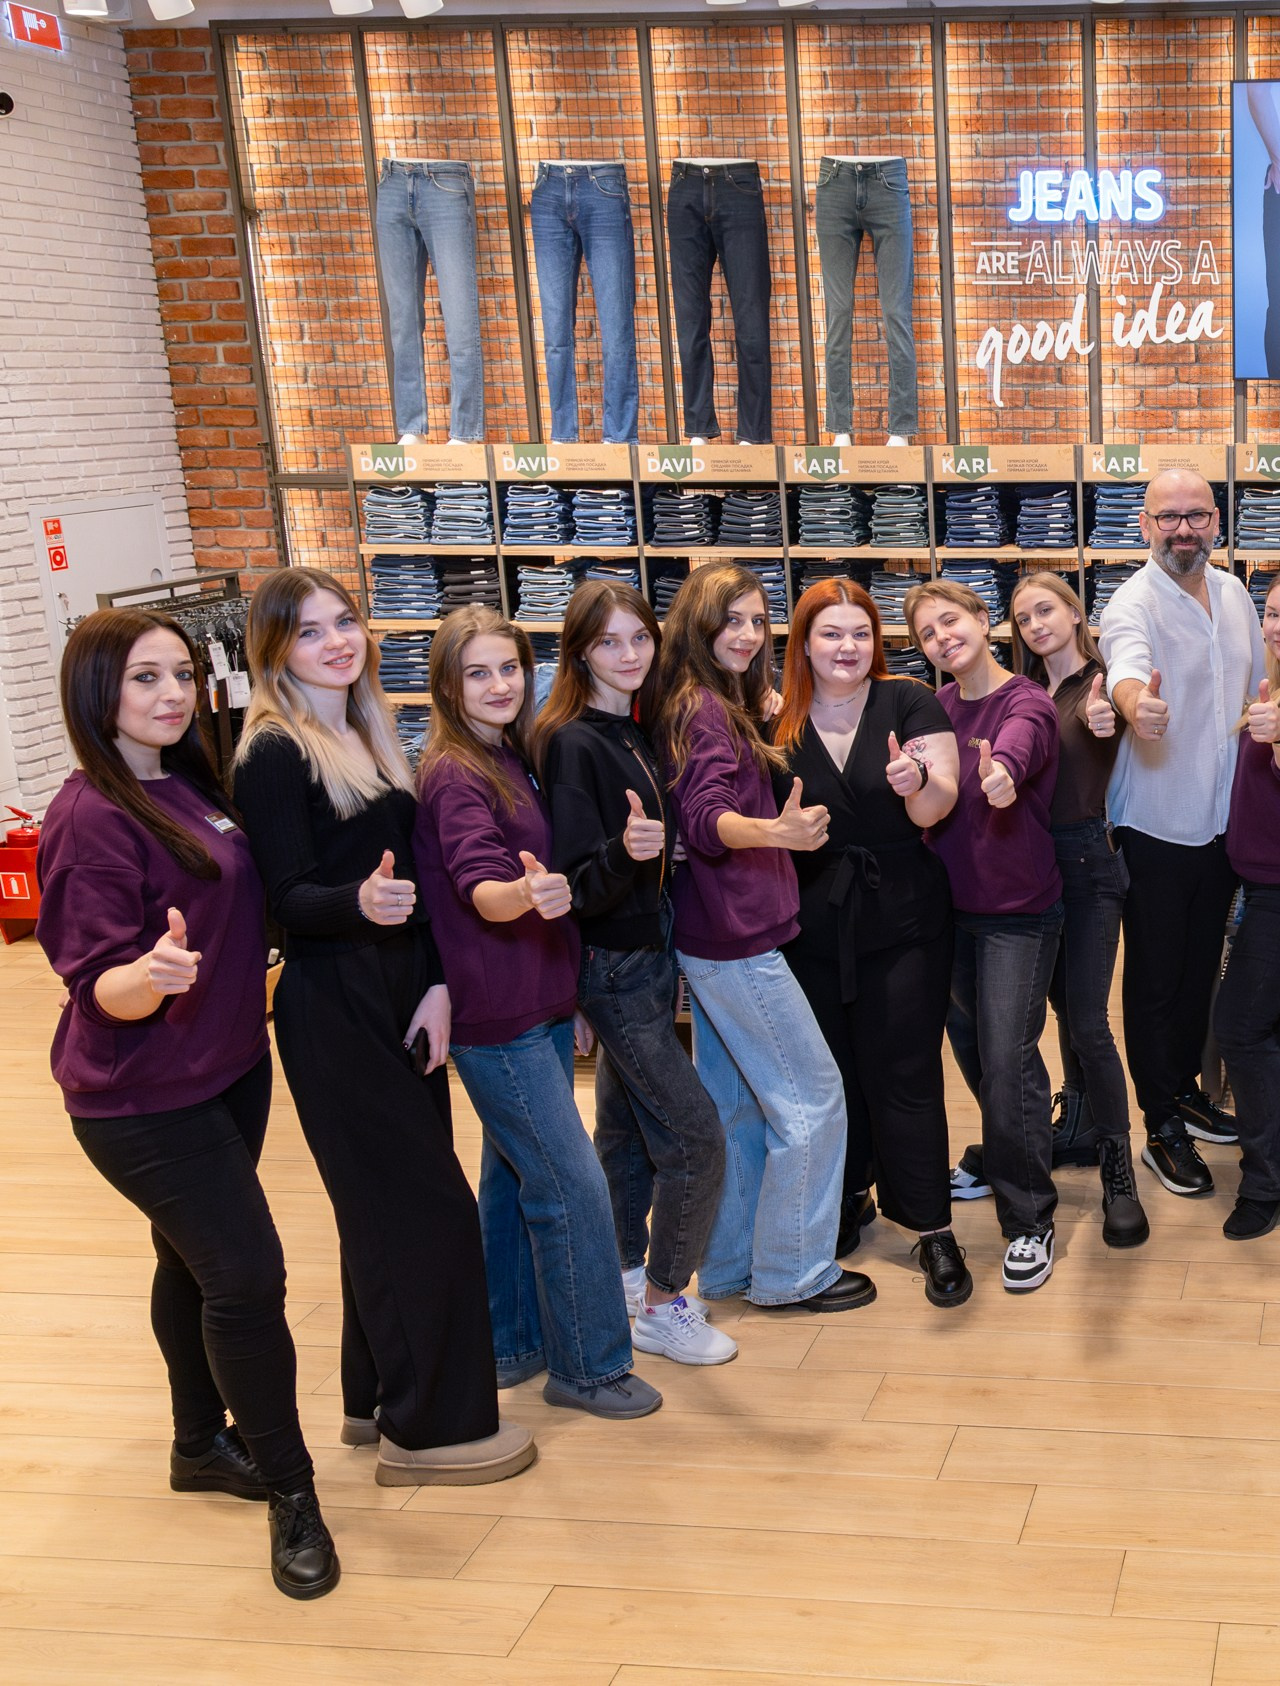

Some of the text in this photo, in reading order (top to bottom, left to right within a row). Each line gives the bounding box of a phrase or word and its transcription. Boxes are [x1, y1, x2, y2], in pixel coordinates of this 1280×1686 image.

[1008, 168, 1164, 222] JEANS
[976, 240, 1220, 285] ARE ALWAYS A
[975, 281, 1225, 408] good idea
[360, 456, 418, 472] DAVID
[503, 456, 560, 472] DAVID
[647, 457, 706, 473] DAVID
[794, 458, 850, 474] KARL
[941, 457, 999, 474] KARL
[1091, 456, 1149, 473] KARL
